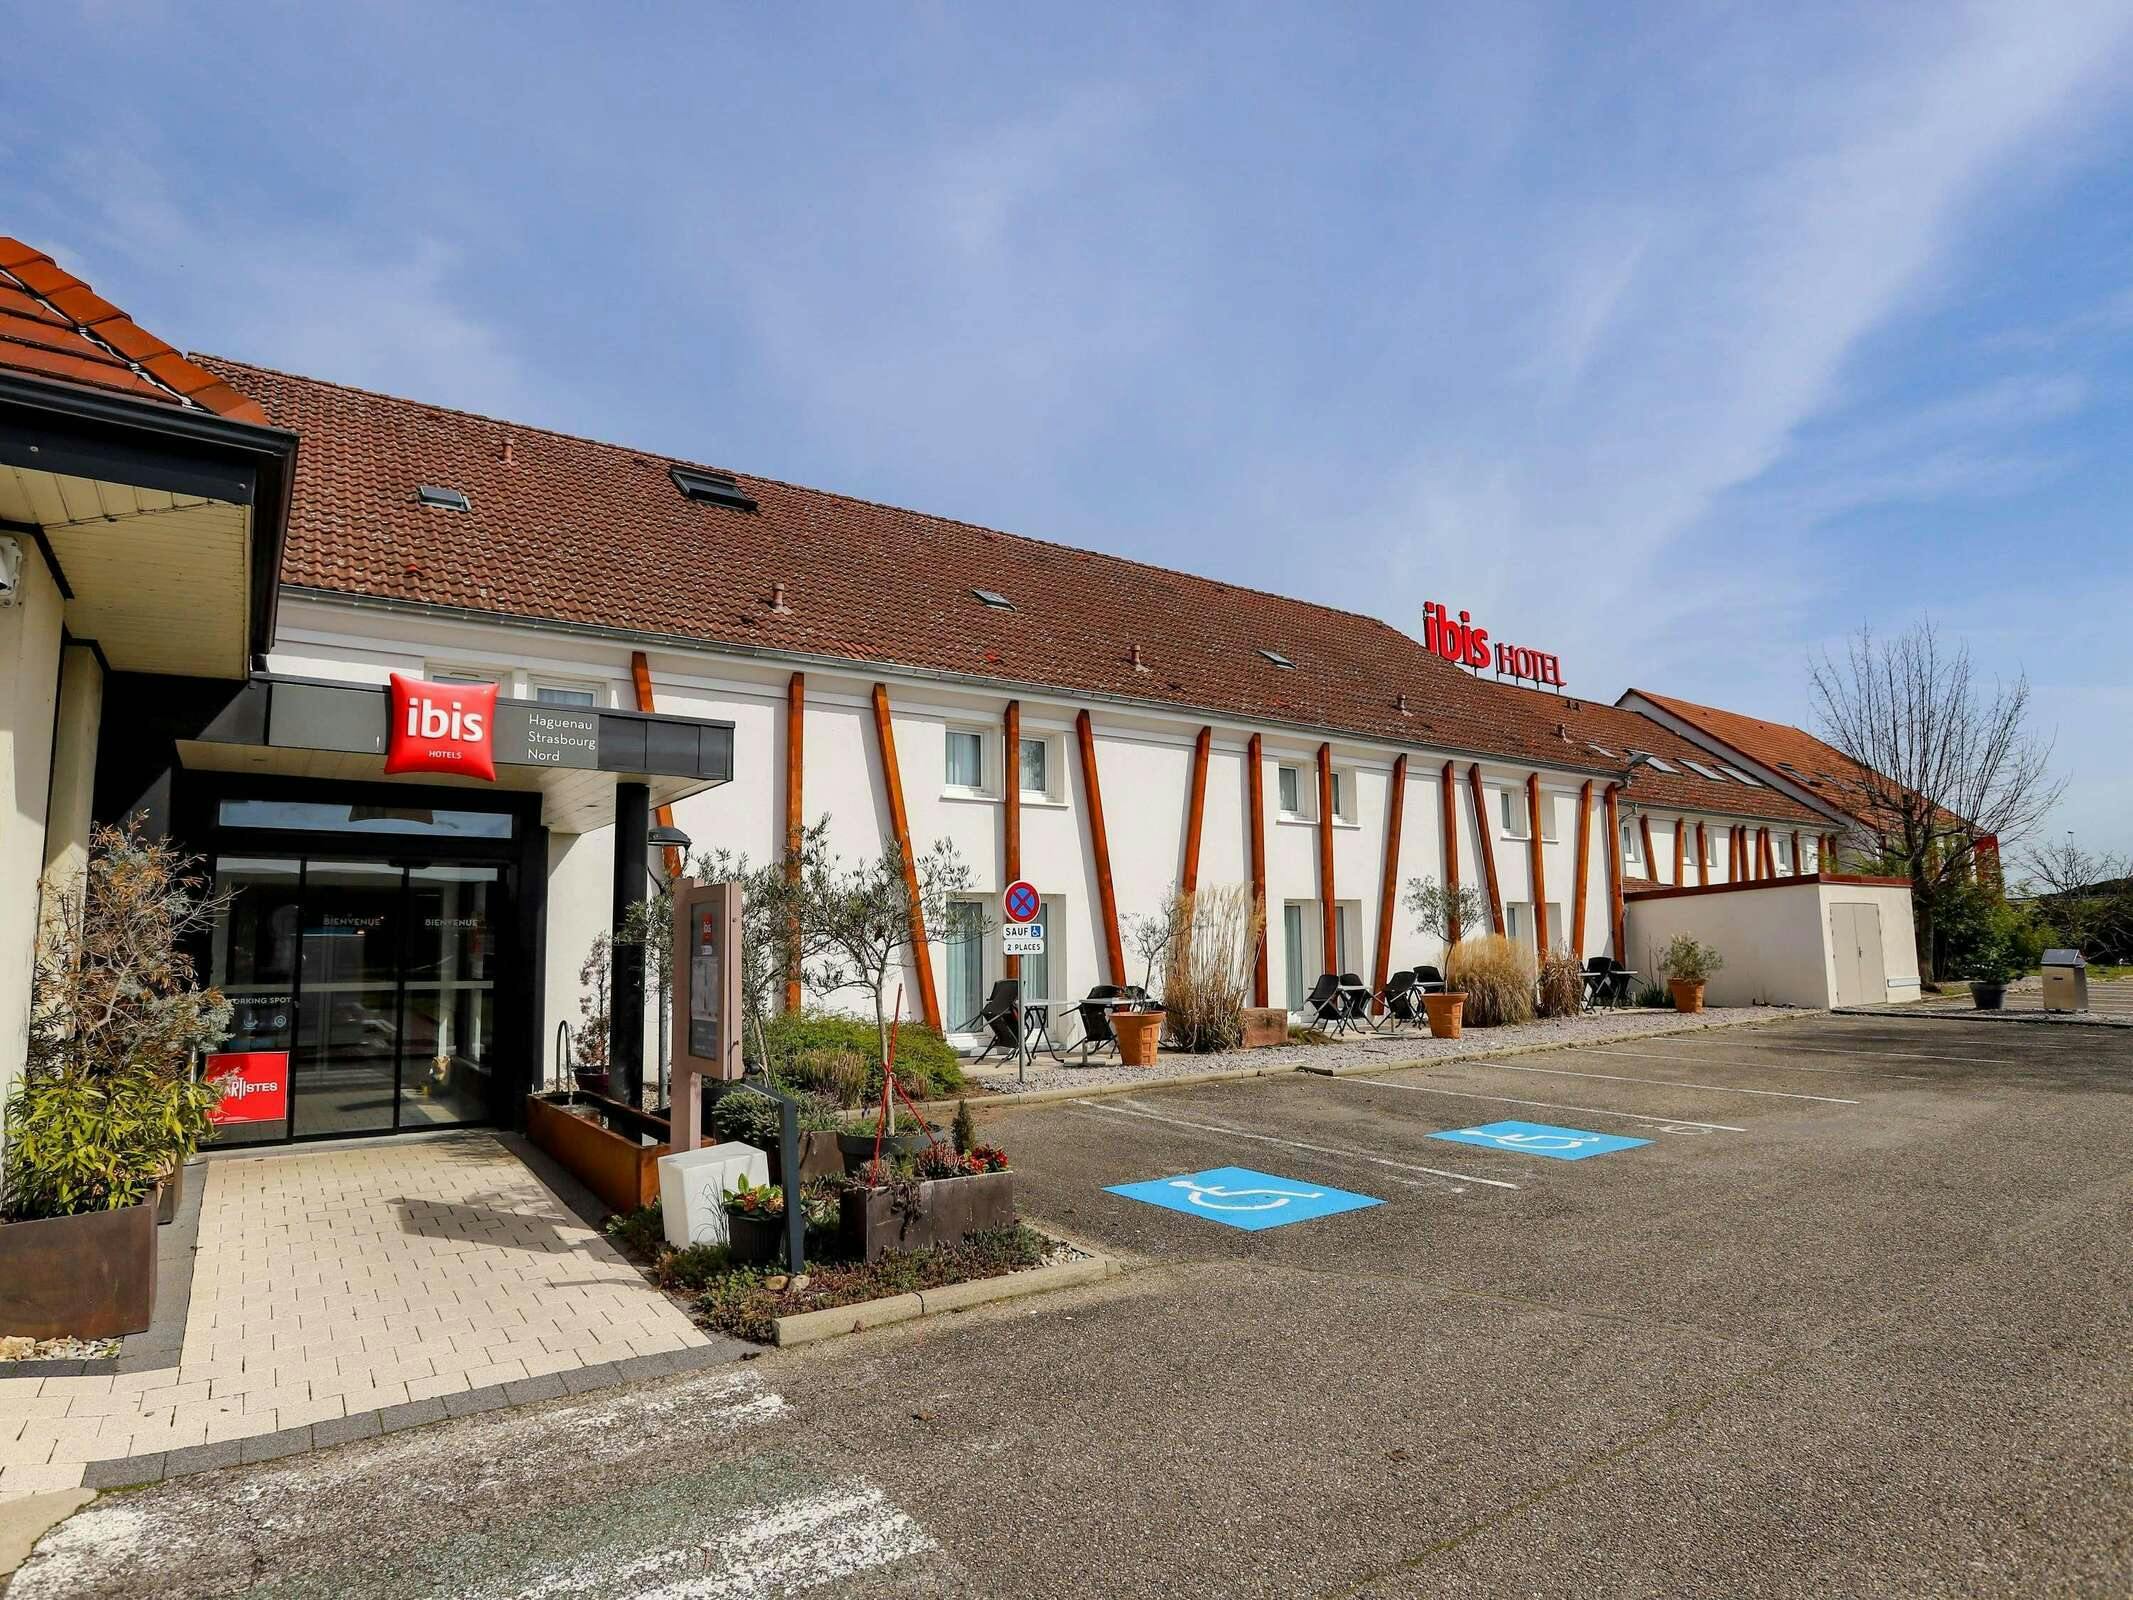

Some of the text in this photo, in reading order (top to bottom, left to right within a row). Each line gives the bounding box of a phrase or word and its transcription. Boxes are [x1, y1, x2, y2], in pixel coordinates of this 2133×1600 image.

[1423, 600, 1567, 687] ibis HOTEL
[407, 697, 484, 742] ibis
[529, 713, 593, 730] Haguenau
[528, 730, 596, 749] Strasbourg
[428, 750, 462, 760] HOTELS
[528, 748, 560, 761] Nord
[323, 918, 381, 926] BIENVENUE
[425, 918, 478, 927] BIENVENUE
[1005, 927, 1029, 936] SAUF
[1014, 943, 1041, 951] PLACES
[231, 996, 293, 1005] ORKING SPOT
